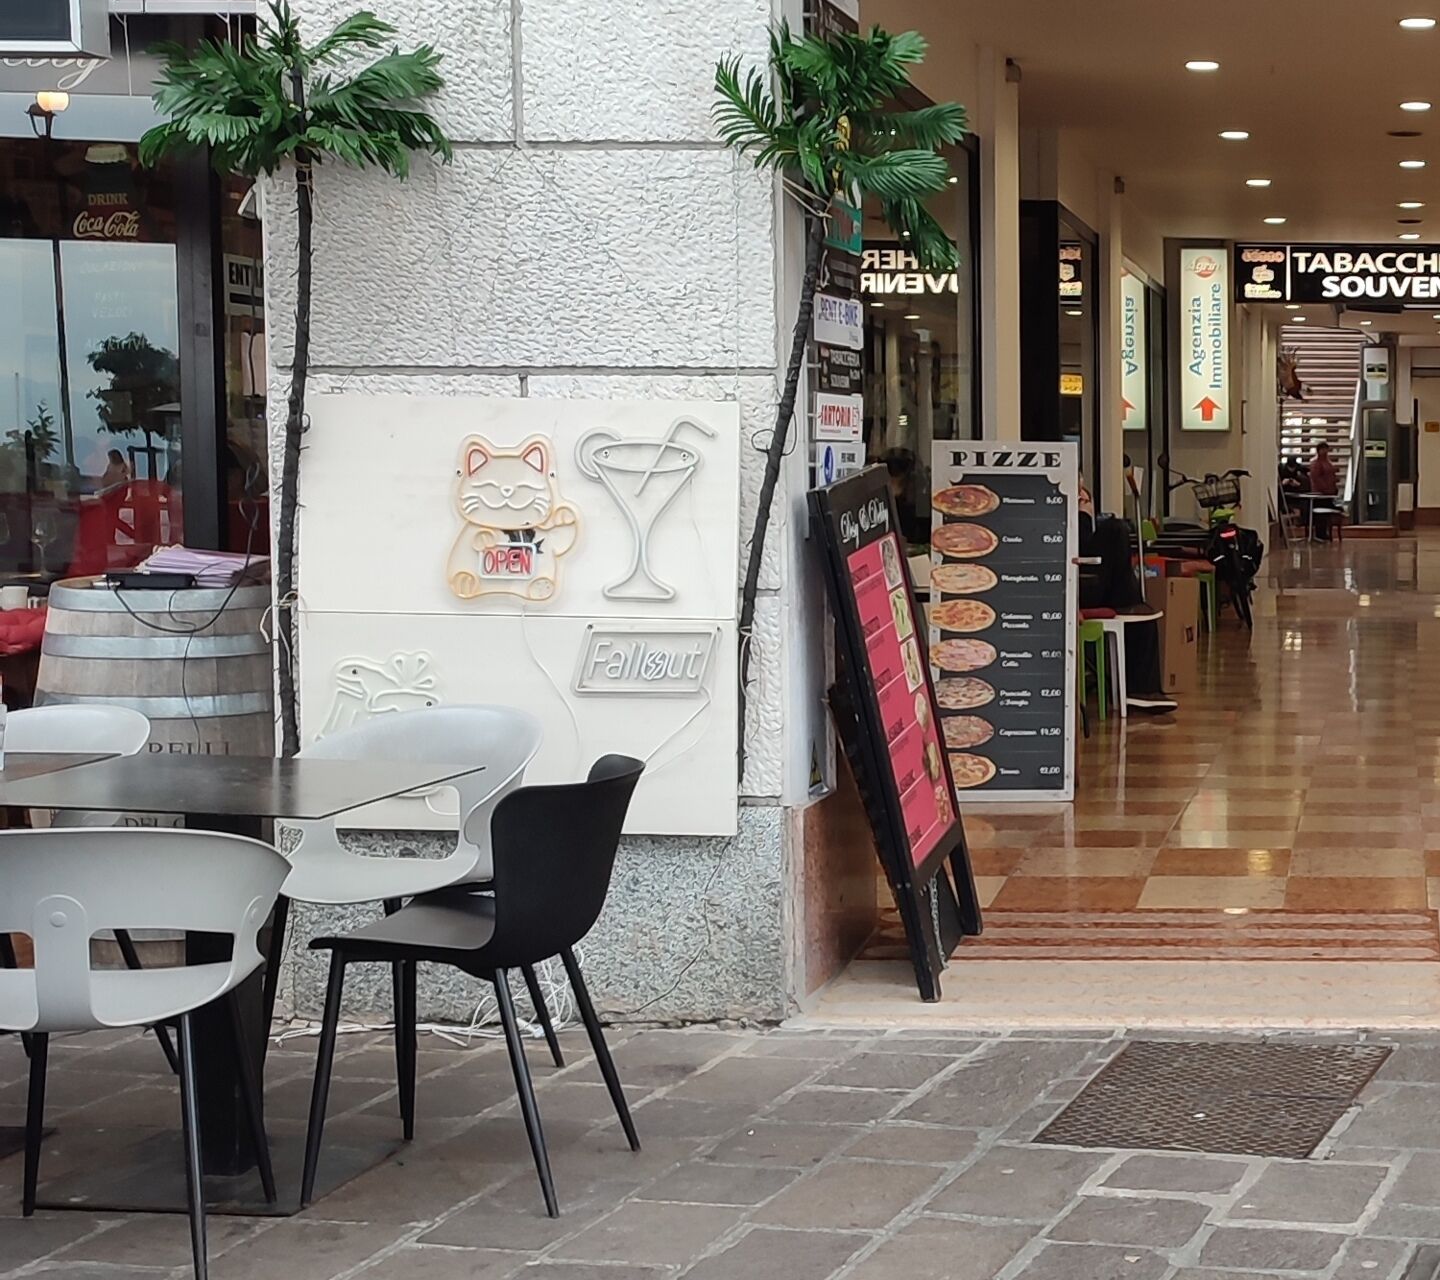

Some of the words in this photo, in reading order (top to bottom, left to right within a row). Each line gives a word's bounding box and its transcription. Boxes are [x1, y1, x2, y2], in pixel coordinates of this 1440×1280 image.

[88, 193, 128, 205] DRINK
[1188, 296, 1206, 376] Agenzia
[1209, 284, 1222, 389] Immobiliare
[950, 451, 1061, 467] PIZZE
[482, 547, 531, 575] OPEN
[587, 639, 703, 681] Fallout
